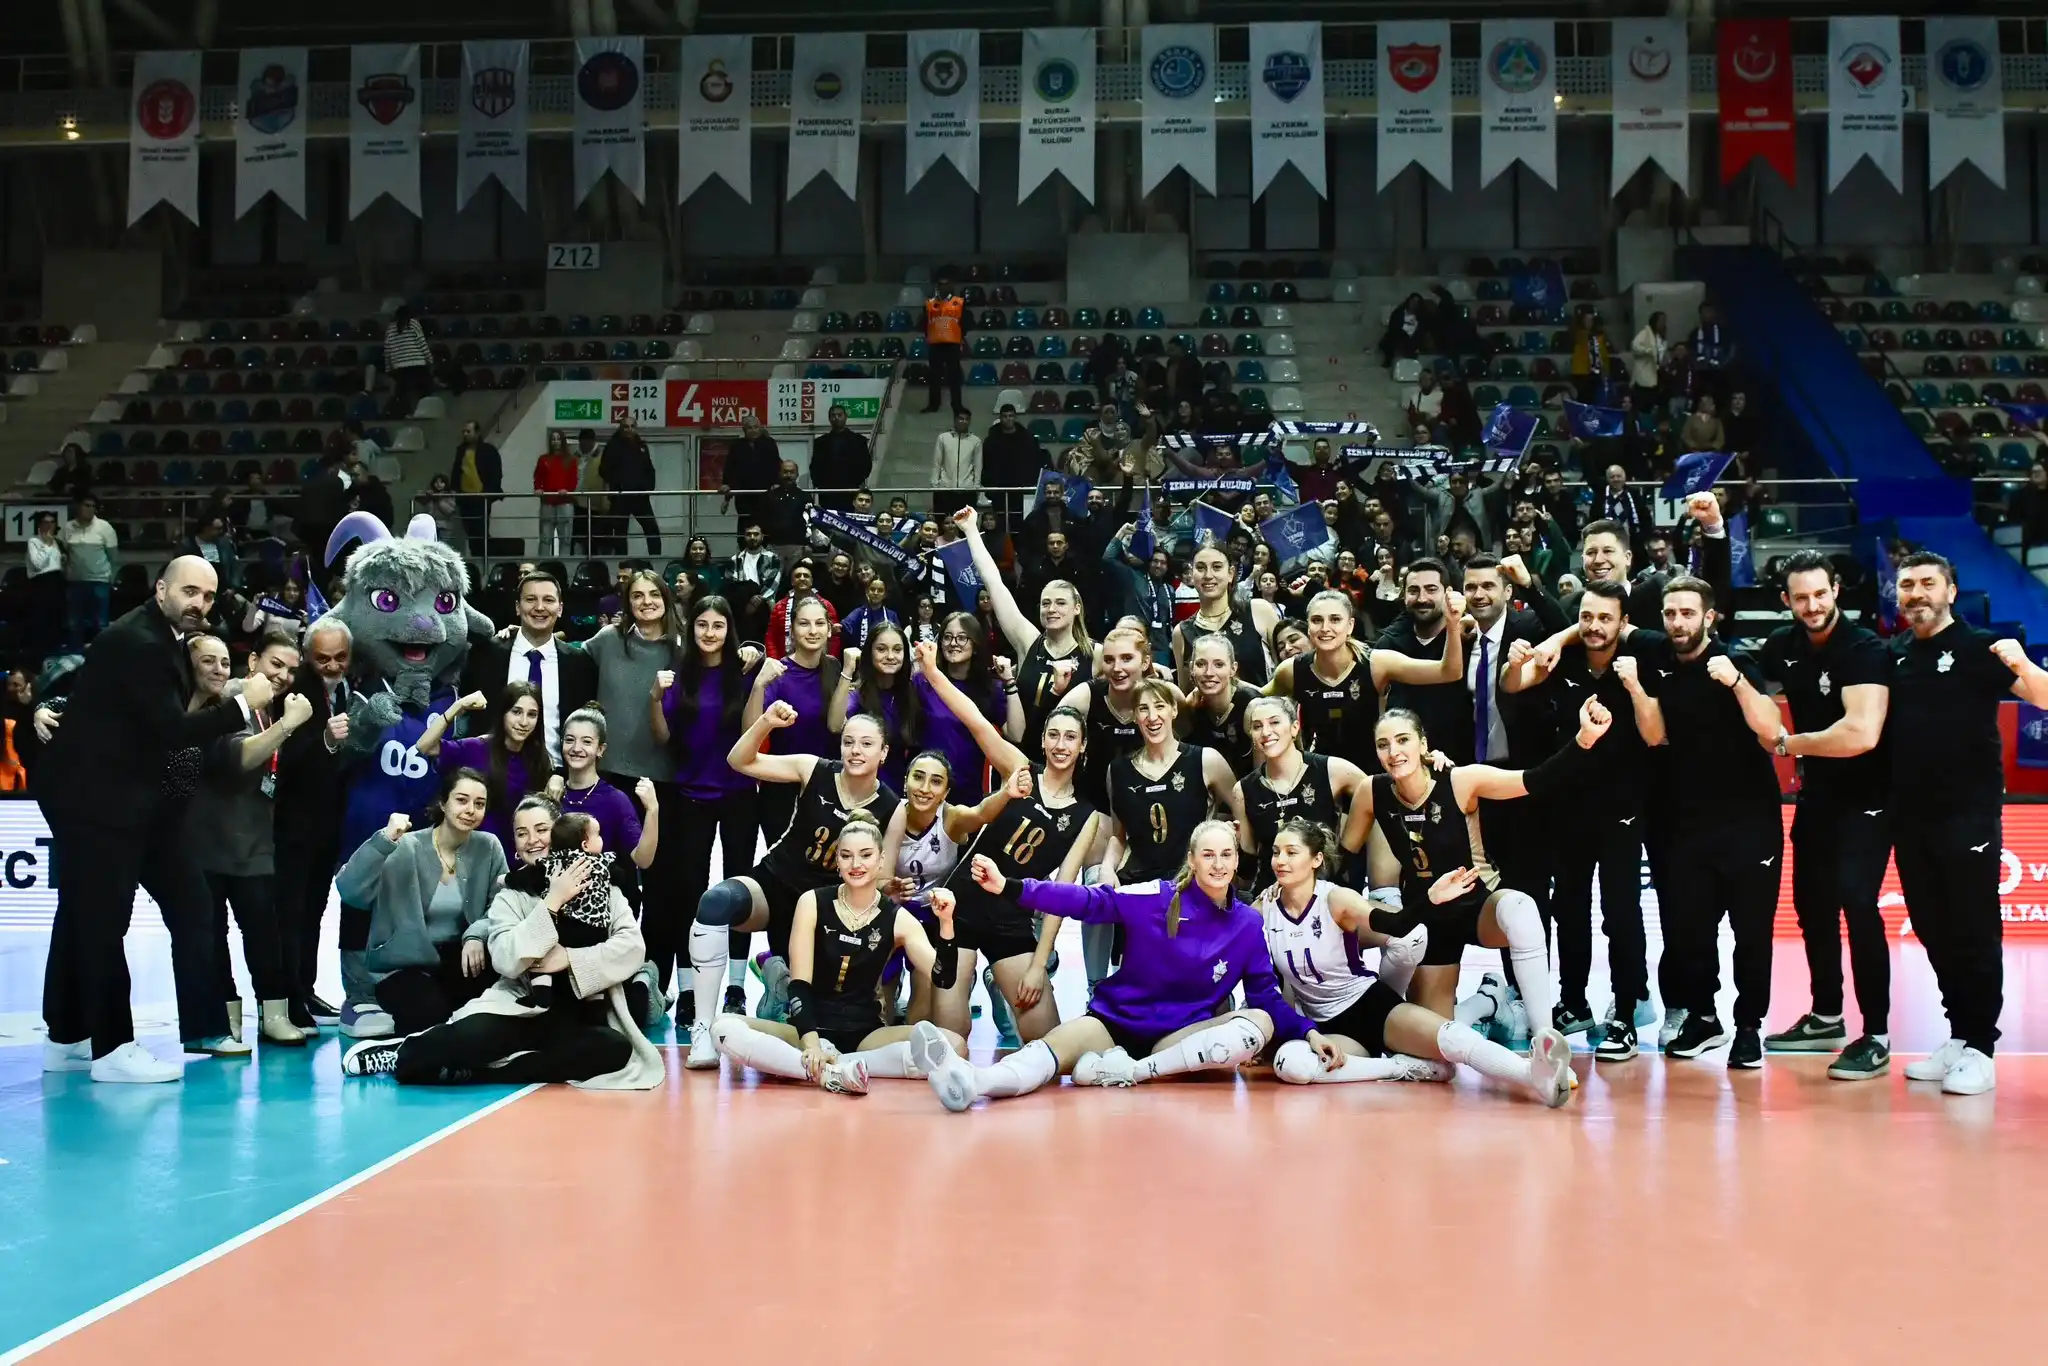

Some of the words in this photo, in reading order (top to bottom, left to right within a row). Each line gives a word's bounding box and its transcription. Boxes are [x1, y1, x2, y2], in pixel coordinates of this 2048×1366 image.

[553, 246, 593, 267] 212
[633, 386, 658, 398] 212
[778, 384, 797, 393] 211
[821, 384, 841, 393] 210
[677, 383, 705, 423] 4
[711, 397, 739, 406] NOLU
[778, 398, 797, 407] 112
[633, 409, 658, 421] 114
[778, 412, 797, 421] 113
[380, 739, 428, 779] 06
[1149, 802, 1168, 844] 9
[1003, 816, 1045, 865] 18
[2001, 903, 2048, 921] LTA
[834, 955, 851, 993] 1
